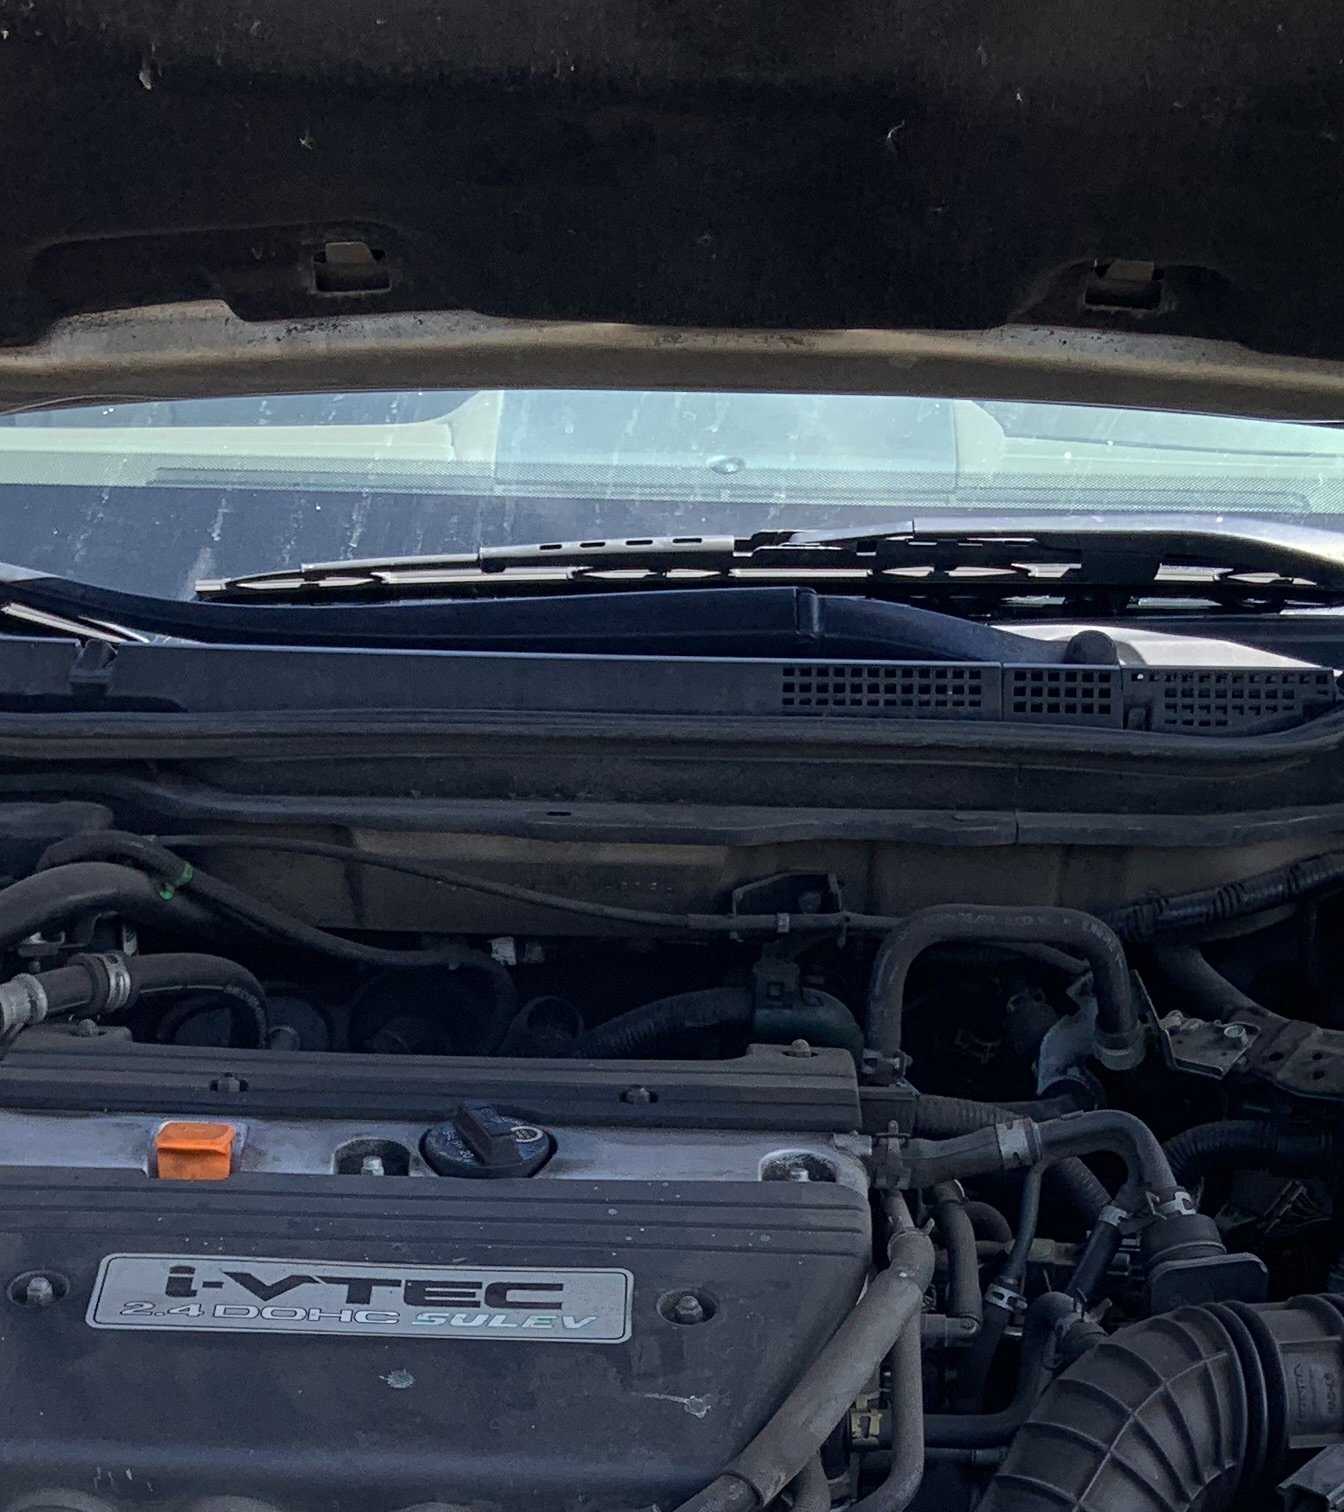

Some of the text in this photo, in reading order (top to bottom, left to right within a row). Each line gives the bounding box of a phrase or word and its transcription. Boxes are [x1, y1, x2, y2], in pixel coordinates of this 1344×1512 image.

[165, 1265, 565, 1311] i-VTEC
[119, 1301, 597, 1331] 2.4 DOHC SULEV
